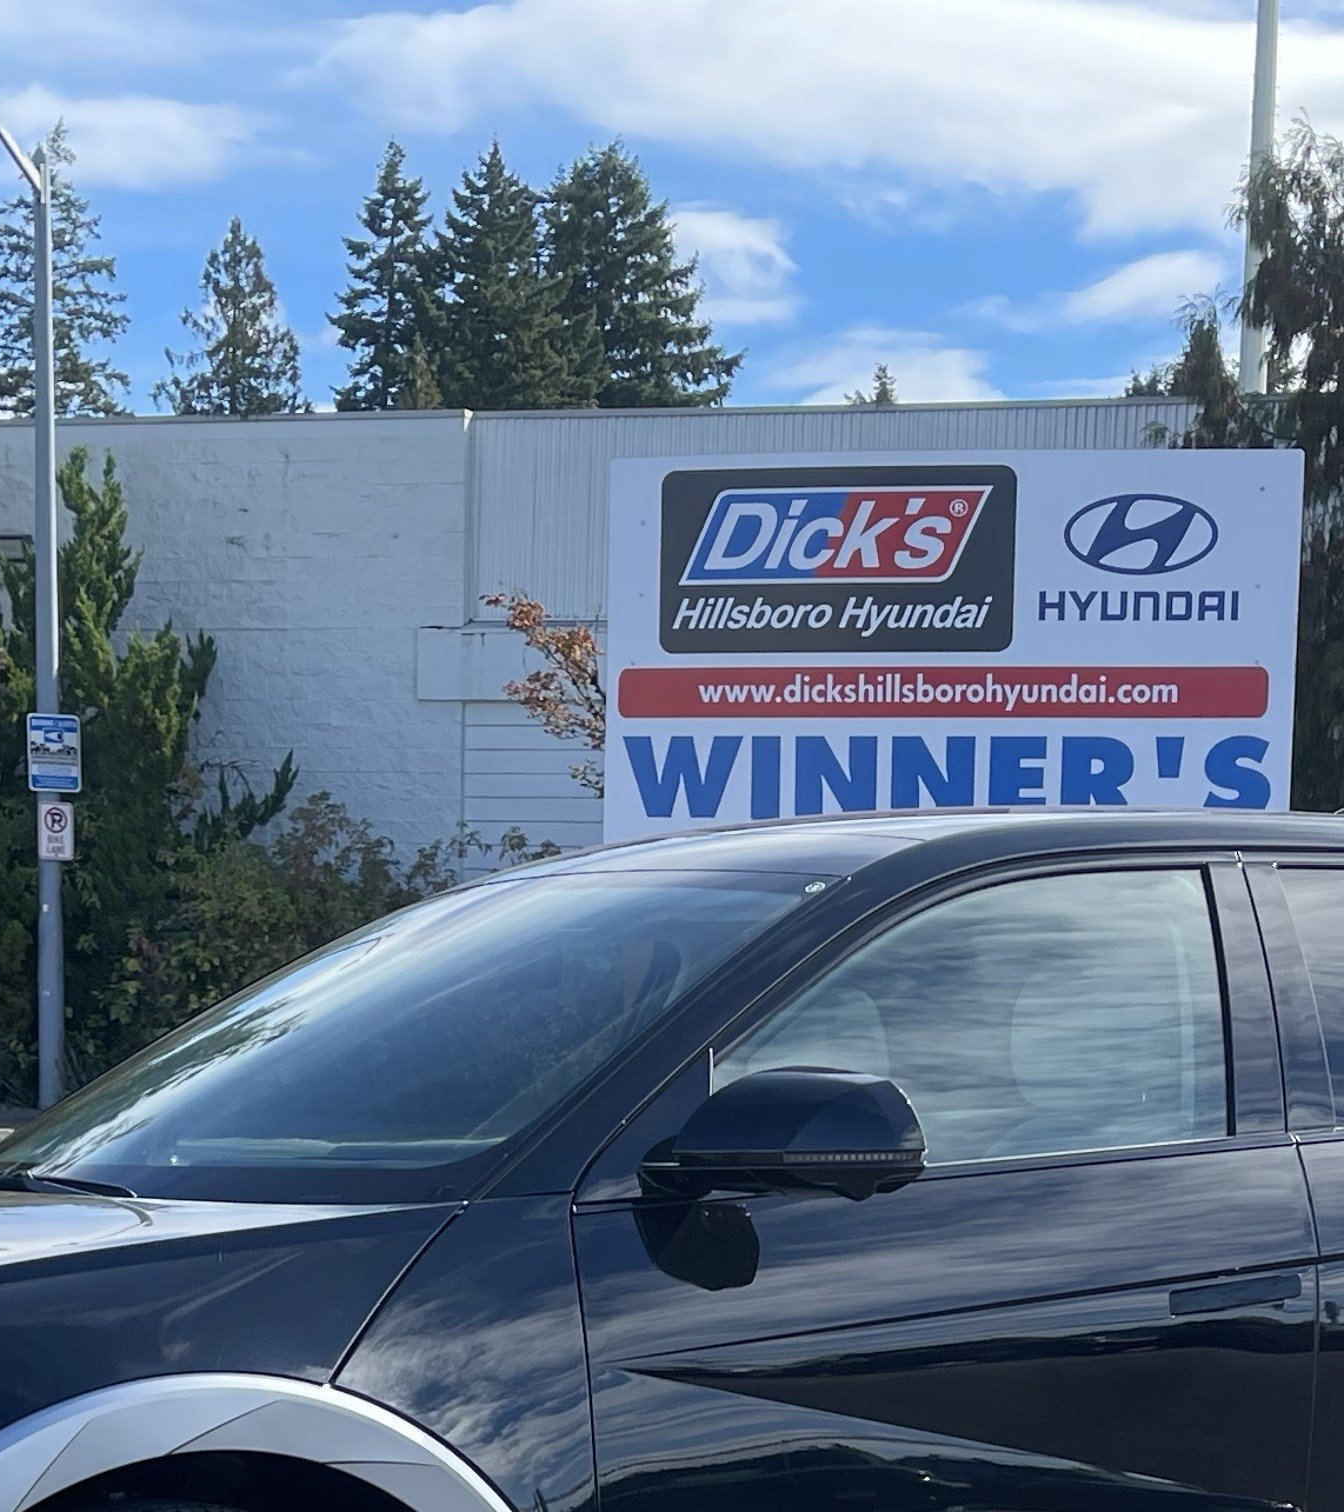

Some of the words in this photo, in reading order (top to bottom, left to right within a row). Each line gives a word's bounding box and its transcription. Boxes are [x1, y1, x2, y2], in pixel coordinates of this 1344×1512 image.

[703, 498, 952, 571] Dick's
[671, 597, 833, 631] Hillsboro
[838, 596, 993, 637] Hyundai
[1038, 590, 1240, 622] HYUNDAI
[698, 673, 1179, 712] www.dickshillsborohyundai.com
[622, 735, 1272, 820] WINNER'S
